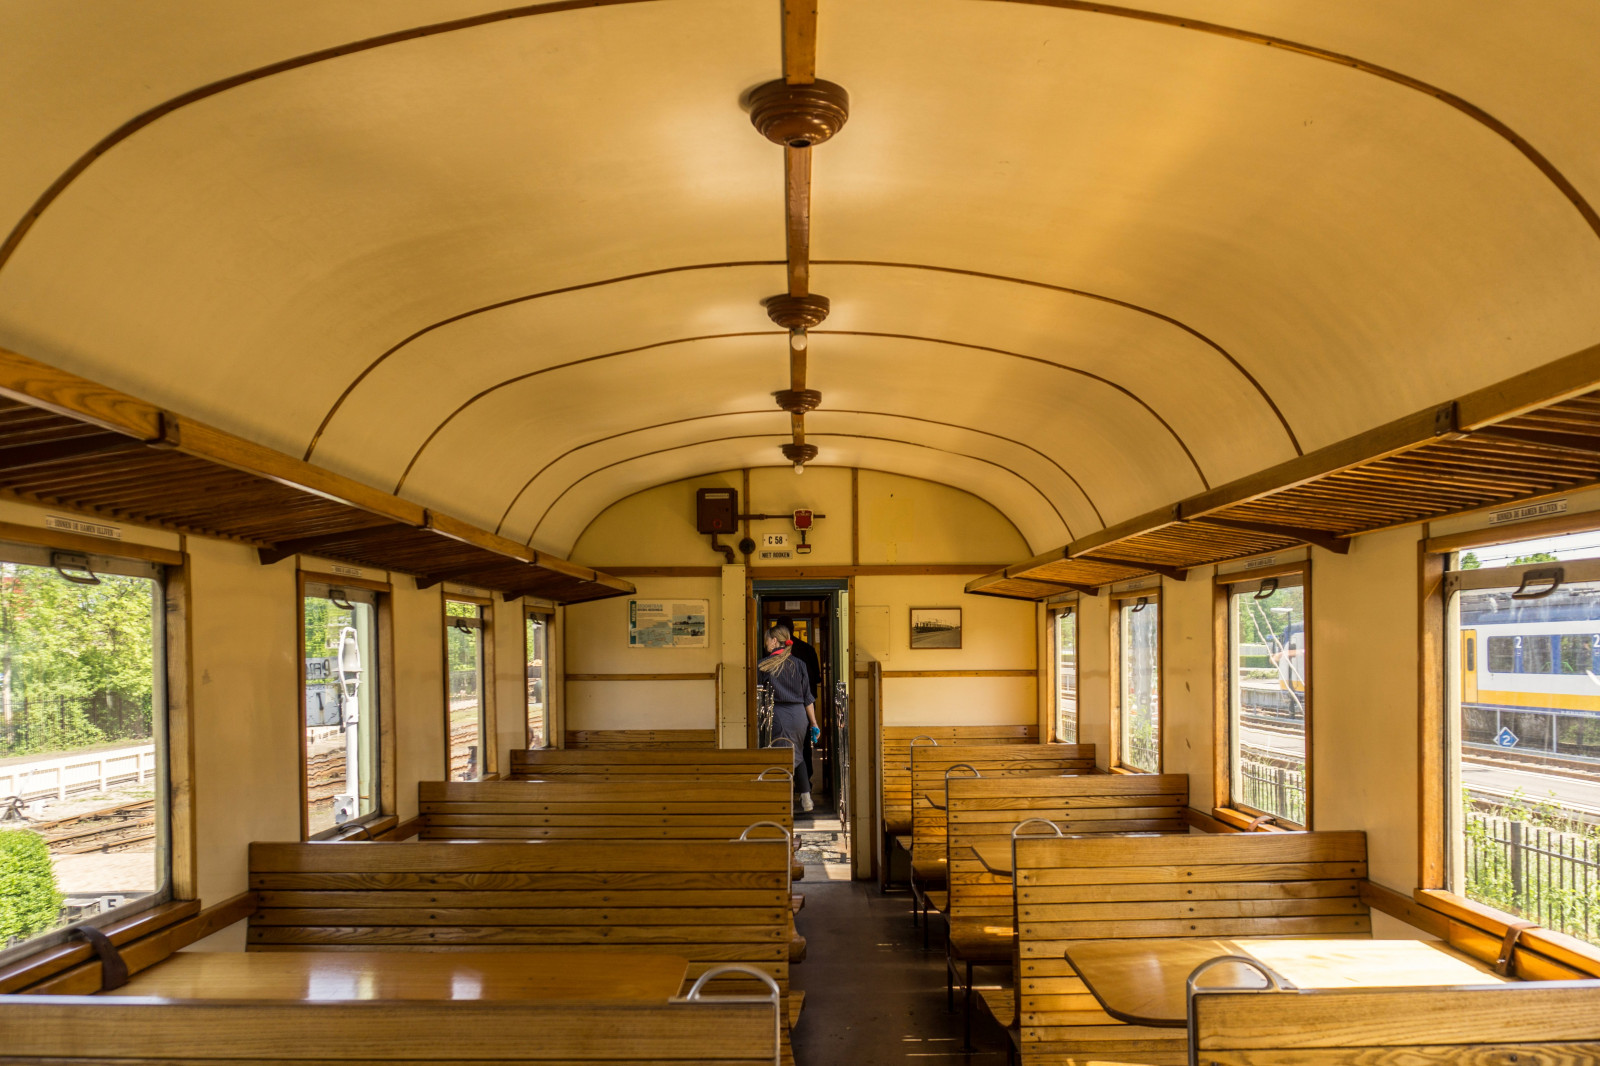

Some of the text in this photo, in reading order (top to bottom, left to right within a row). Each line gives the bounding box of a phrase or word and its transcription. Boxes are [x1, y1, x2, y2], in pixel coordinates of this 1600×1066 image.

[768, 536, 783, 544] C 58
[1515, 636, 1522, 649] 2
[1593, 634, 1600, 647] 2
[1502, 735, 1511, 746] 2
